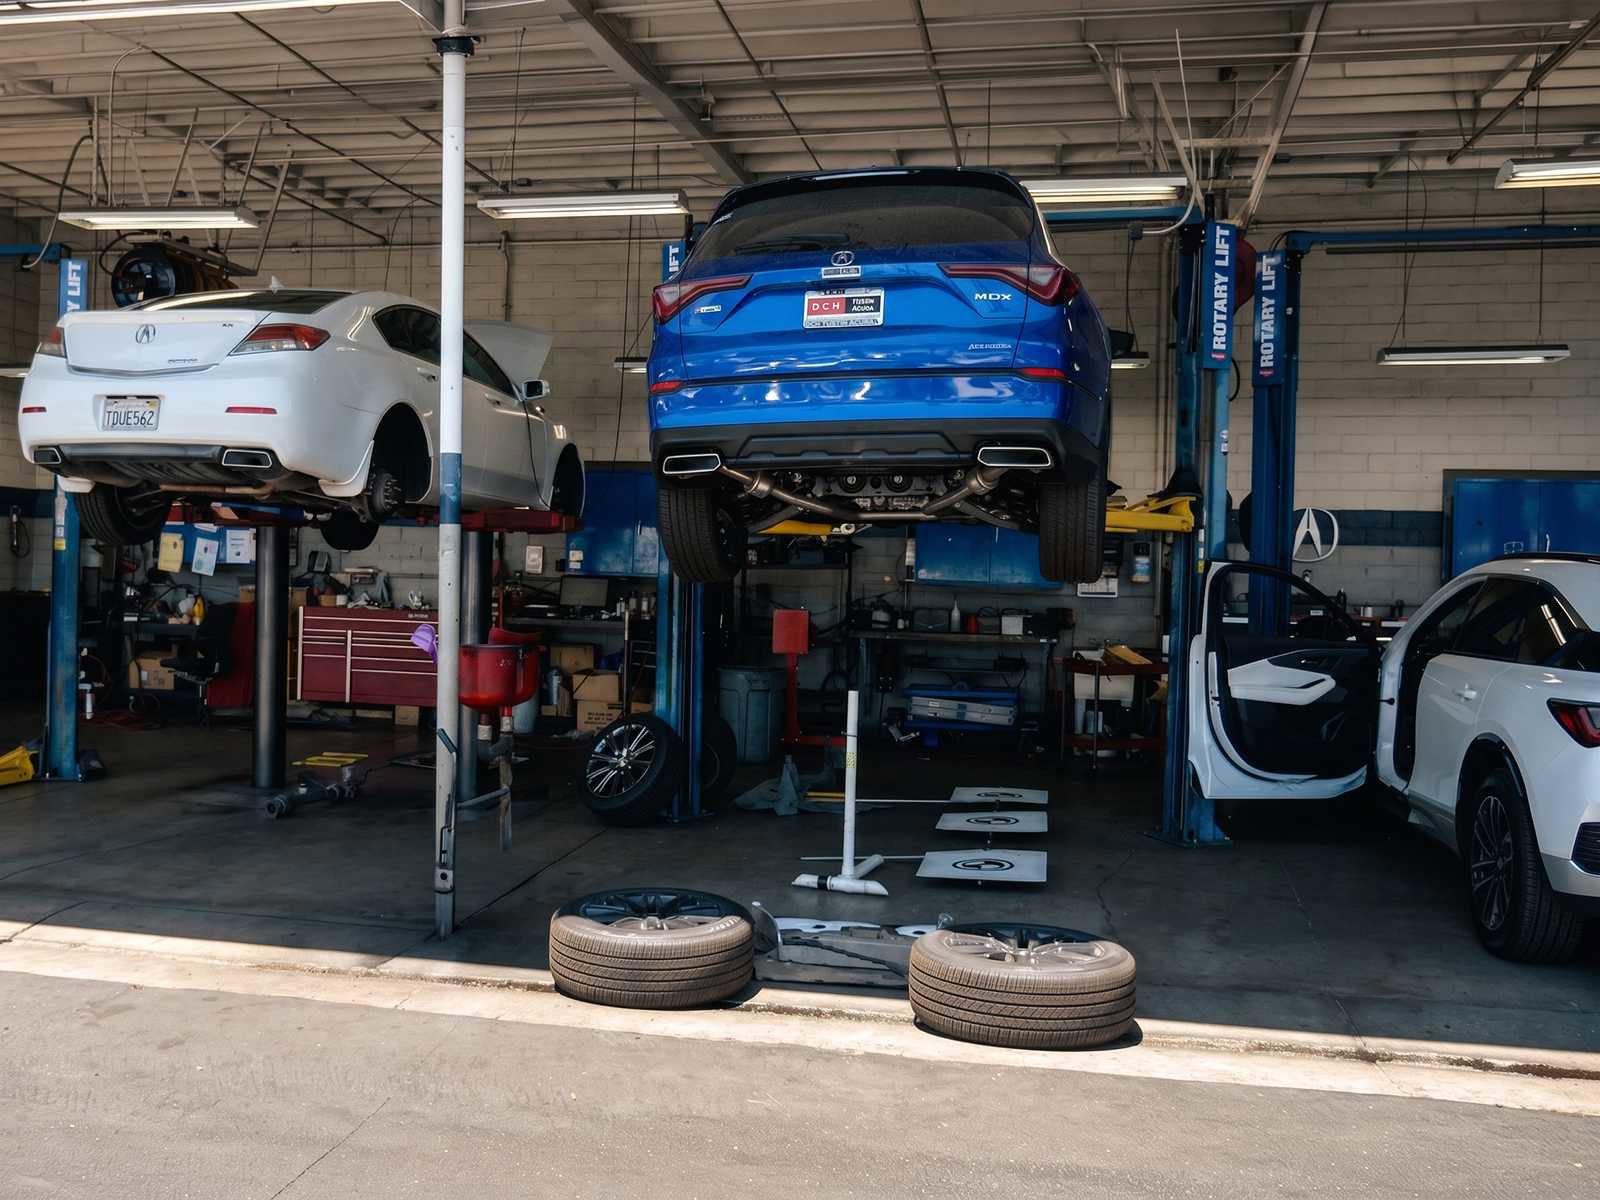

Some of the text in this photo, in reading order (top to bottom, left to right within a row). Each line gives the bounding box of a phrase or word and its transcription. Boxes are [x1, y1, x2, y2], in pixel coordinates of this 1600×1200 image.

[668, 245, 680, 279] IFT
[1215, 226, 1230, 267] LIFT
[68, 261, 81, 296] LIFT
[1262, 254, 1279, 291] LIFT
[812, 302, 840, 311] DCH
[974, 293, 1012, 301] MDX
[1213, 272, 1229, 350] ROTARY
[1260, 297, 1275, 367] ROTARY
